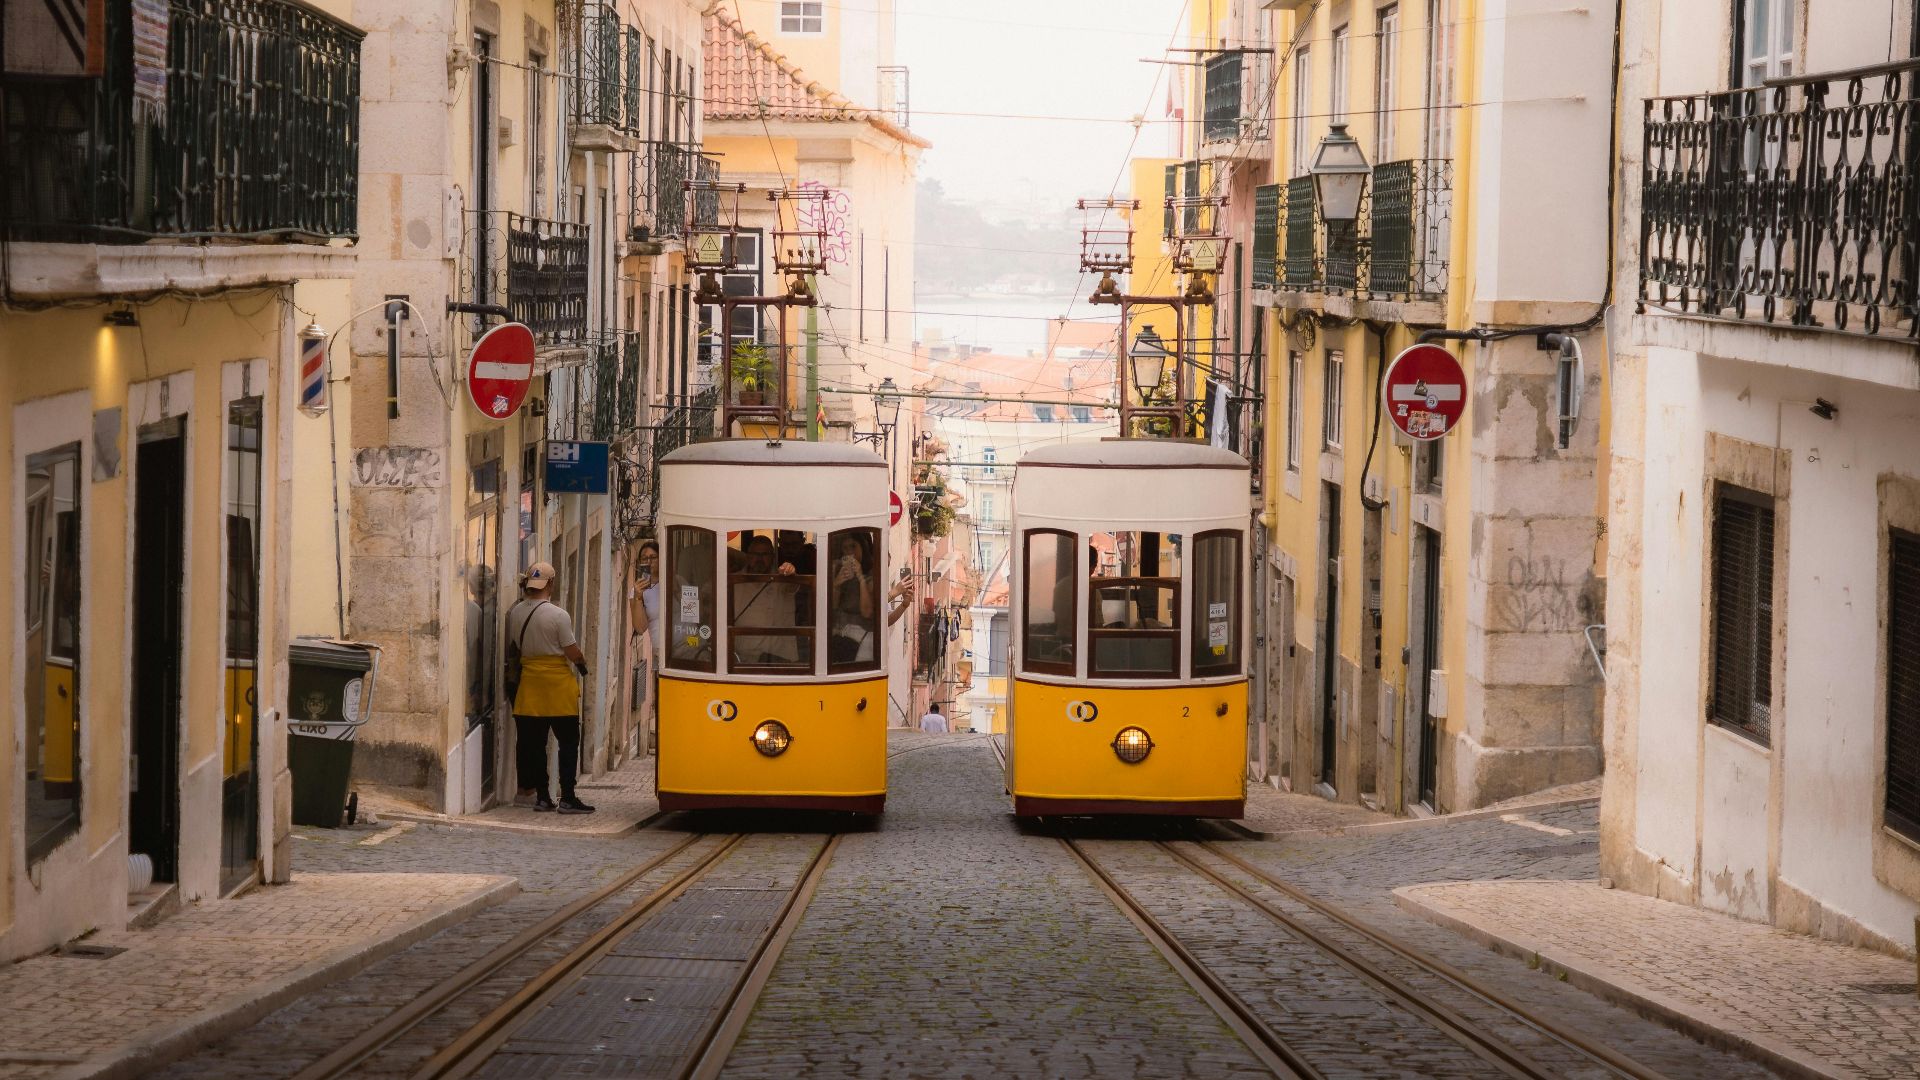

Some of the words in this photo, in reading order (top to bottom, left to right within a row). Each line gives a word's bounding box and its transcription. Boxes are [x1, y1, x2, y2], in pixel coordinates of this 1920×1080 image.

[547, 442, 580, 460] BH
[818, 700, 823, 711] 1
[1182, 706, 1190, 718] 2
[299, 724, 327, 734] LIXO
